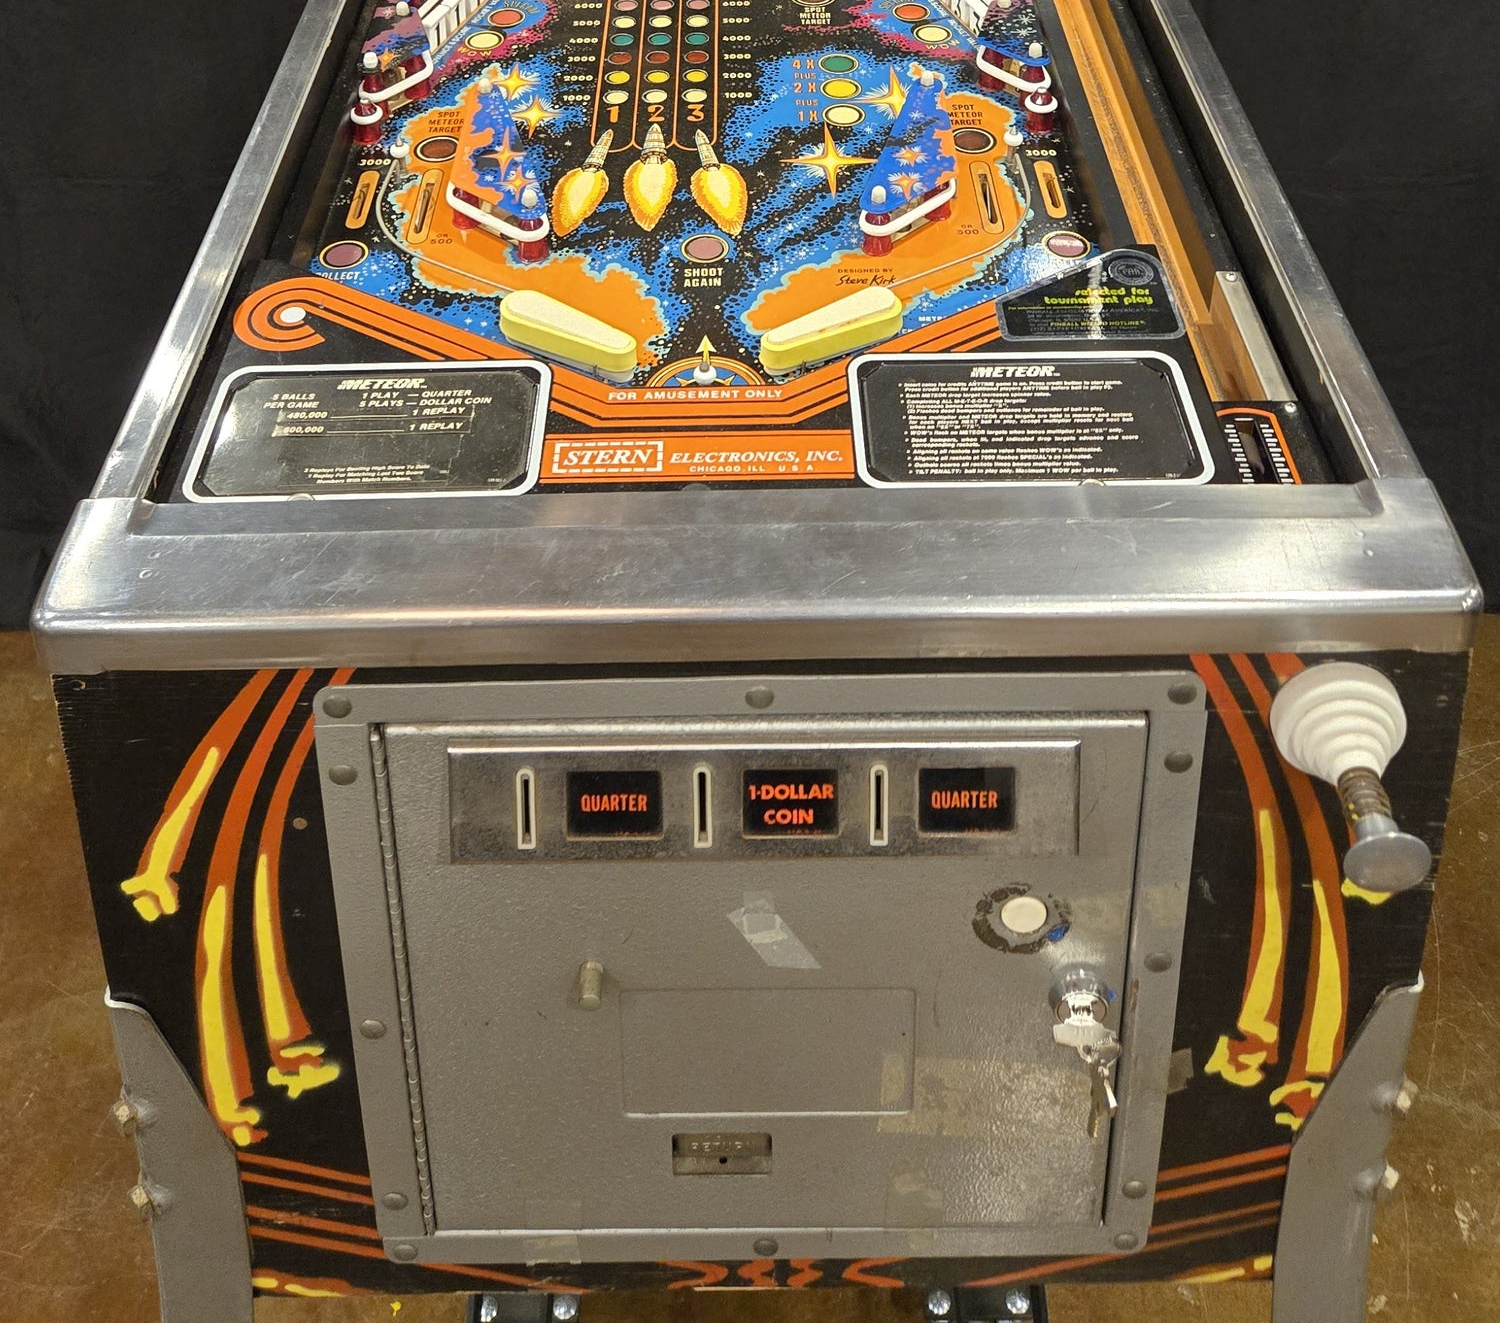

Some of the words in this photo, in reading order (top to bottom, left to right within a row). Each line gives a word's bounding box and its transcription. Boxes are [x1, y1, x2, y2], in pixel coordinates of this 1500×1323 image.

[926, 39, 960, 50] WOW
[457, 46, 492, 57] WOW
[563, 74, 593, 82] 2000
[794, 72, 817, 80] PLUS
[563, 94, 591, 102] 1000
[606, 105, 619, 123] 1
[647, 104, 665, 122] 2
[687, 103, 705, 122] 3
[428, 118, 465, 126] METEOR
[428, 125, 463, 133] TARGET
[1025, 149, 1057, 157] 3000
[359, 158, 391, 166] 3000
[683, 267, 723, 278] SHOOT
[684, 277, 722, 287] AGAIN
[836, 275, 868, 287] Steve
[869, 275, 897, 286] Kirk
[1075, 287, 1127, 297] selected
[1131, 287, 1150, 296] for
[1123, 296, 1154, 306] play
[970, 366, 1056, 378] METEOR
[337, 378, 427, 390] METEOR
[281, 392, 316, 400] BALLS
[370, 391, 400, 399] PLAY
[421, 389, 472, 397] QUARTER
[608, 391, 637, 401] FOR
[643, 389, 741, 400] AMUSEMENT
[745, 389, 784, 398] ONLY
[263, 401, 286, 409] PER
[287, 401, 319, 409] GAME
[367, 399, 404, 407] PLAYS
[419, 397, 465, 406] DOLLAR
[466, 396, 492, 405] COIN
[286, 411, 328, 420] 480,000
[421, 407, 466, 416] REPLAY
[283, 426, 324, 434] 600,000
[419, 422, 463, 431] REPLAY
[562, 448, 656, 467] STERN
[669, 451, 800, 465] ELECTRONICS,
[805, 450, 844, 463] INC.
[748, 783, 835, 801] 1-DOLLAR
[580, 794, 648, 812] QUARTER
[931, 790, 998, 810] QUARTER
[763, 809, 815, 825] COIN
